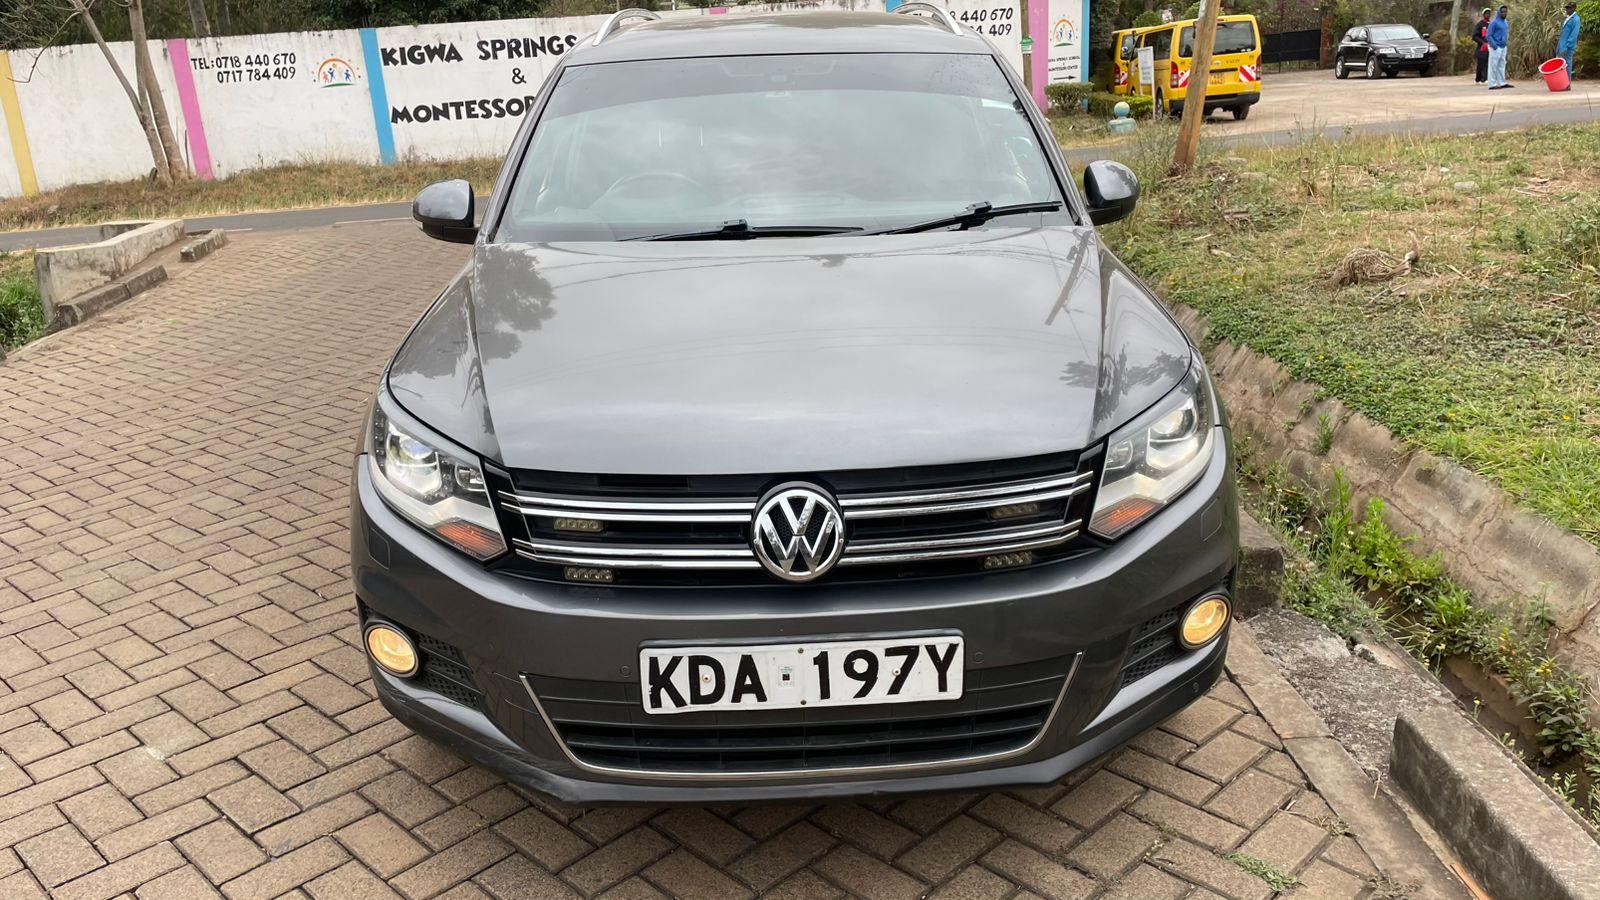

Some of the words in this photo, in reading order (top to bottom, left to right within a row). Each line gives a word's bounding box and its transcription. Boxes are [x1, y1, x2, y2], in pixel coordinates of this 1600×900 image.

[960, 9, 987, 23] 440
[990, 7, 1013, 20] 670
[989, 23, 1012, 36] 409
[380, 42, 464, 67] KIGWA
[476, 34, 578, 60] SPRINGS
[244, 54, 270, 67] 440
[273, 52, 296, 65] 670
[217, 70, 243, 83] 0717
[246, 68, 271, 81] 784
[273, 66, 296, 80] 409
[511, 67, 527, 85] &
[648, 654, 768, 709] KDA
[812, 642, 961, 700] 197Y
